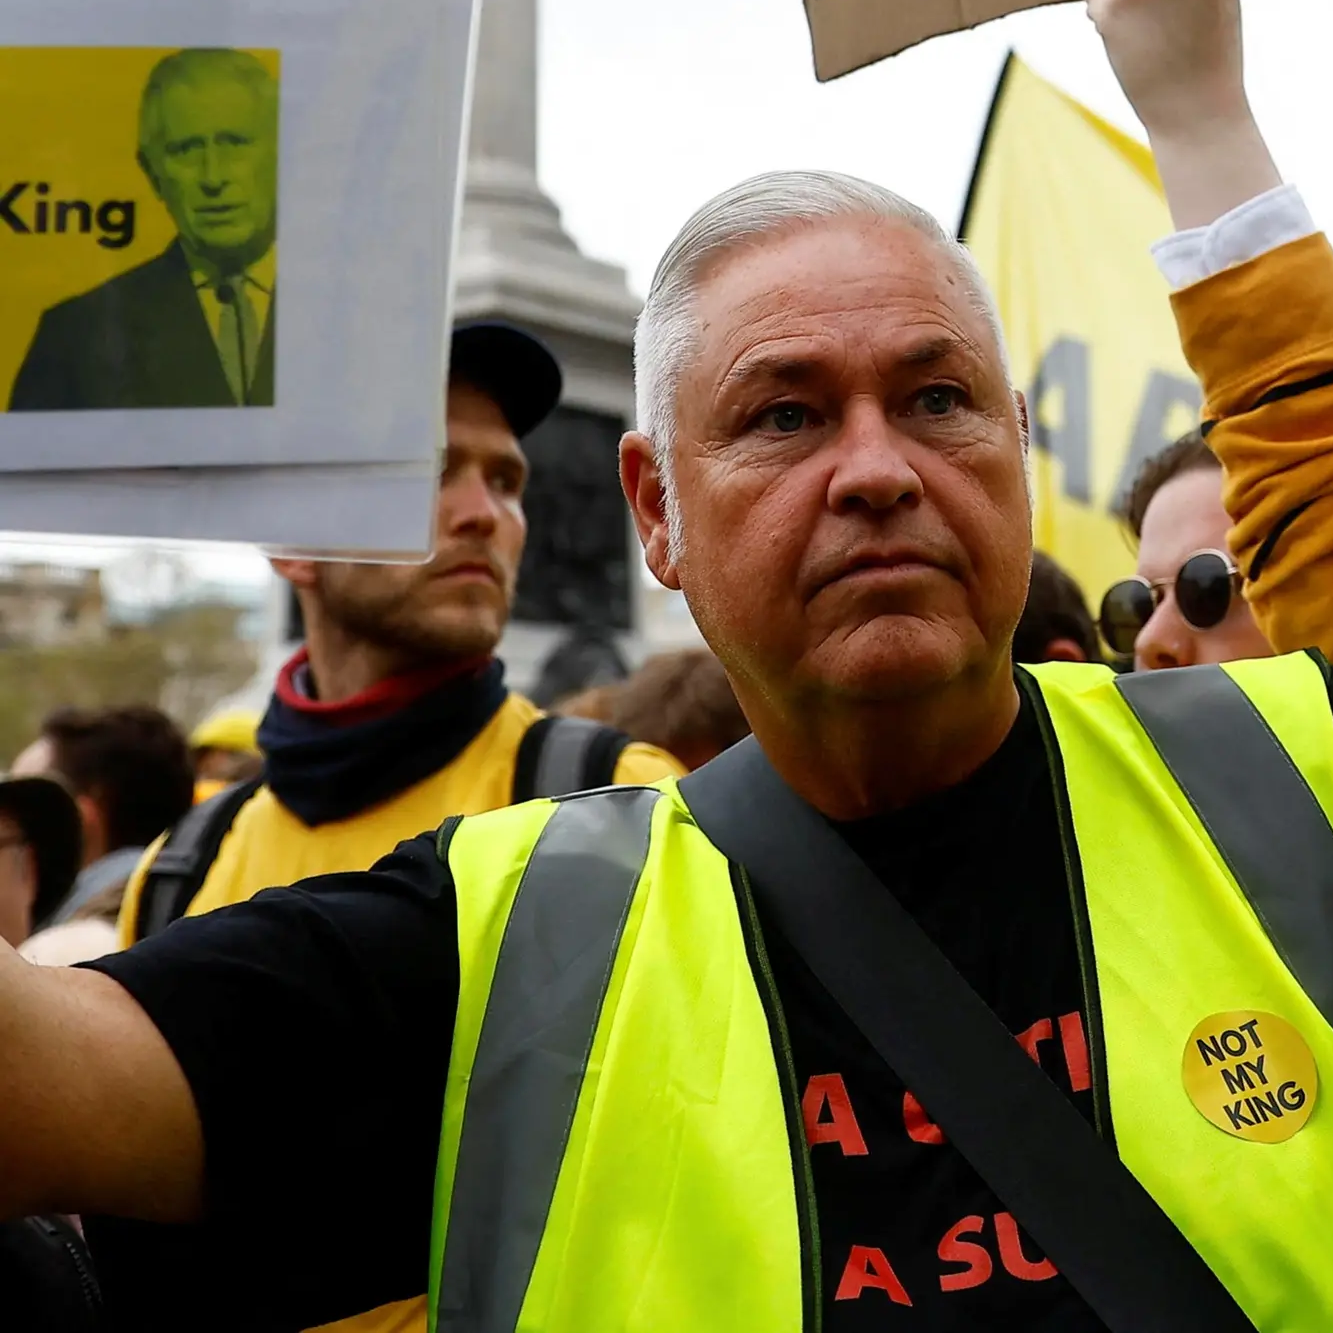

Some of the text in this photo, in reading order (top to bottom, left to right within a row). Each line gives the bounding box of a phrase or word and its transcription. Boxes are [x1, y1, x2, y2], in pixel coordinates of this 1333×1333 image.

[0, 182, 135, 250] King
[1196, 1018, 1263, 1067] NOT
[1220, 1054, 1269, 1095] MY
[1223, 1080, 1306, 1130] KING
[834, 1244, 914, 1307] A
